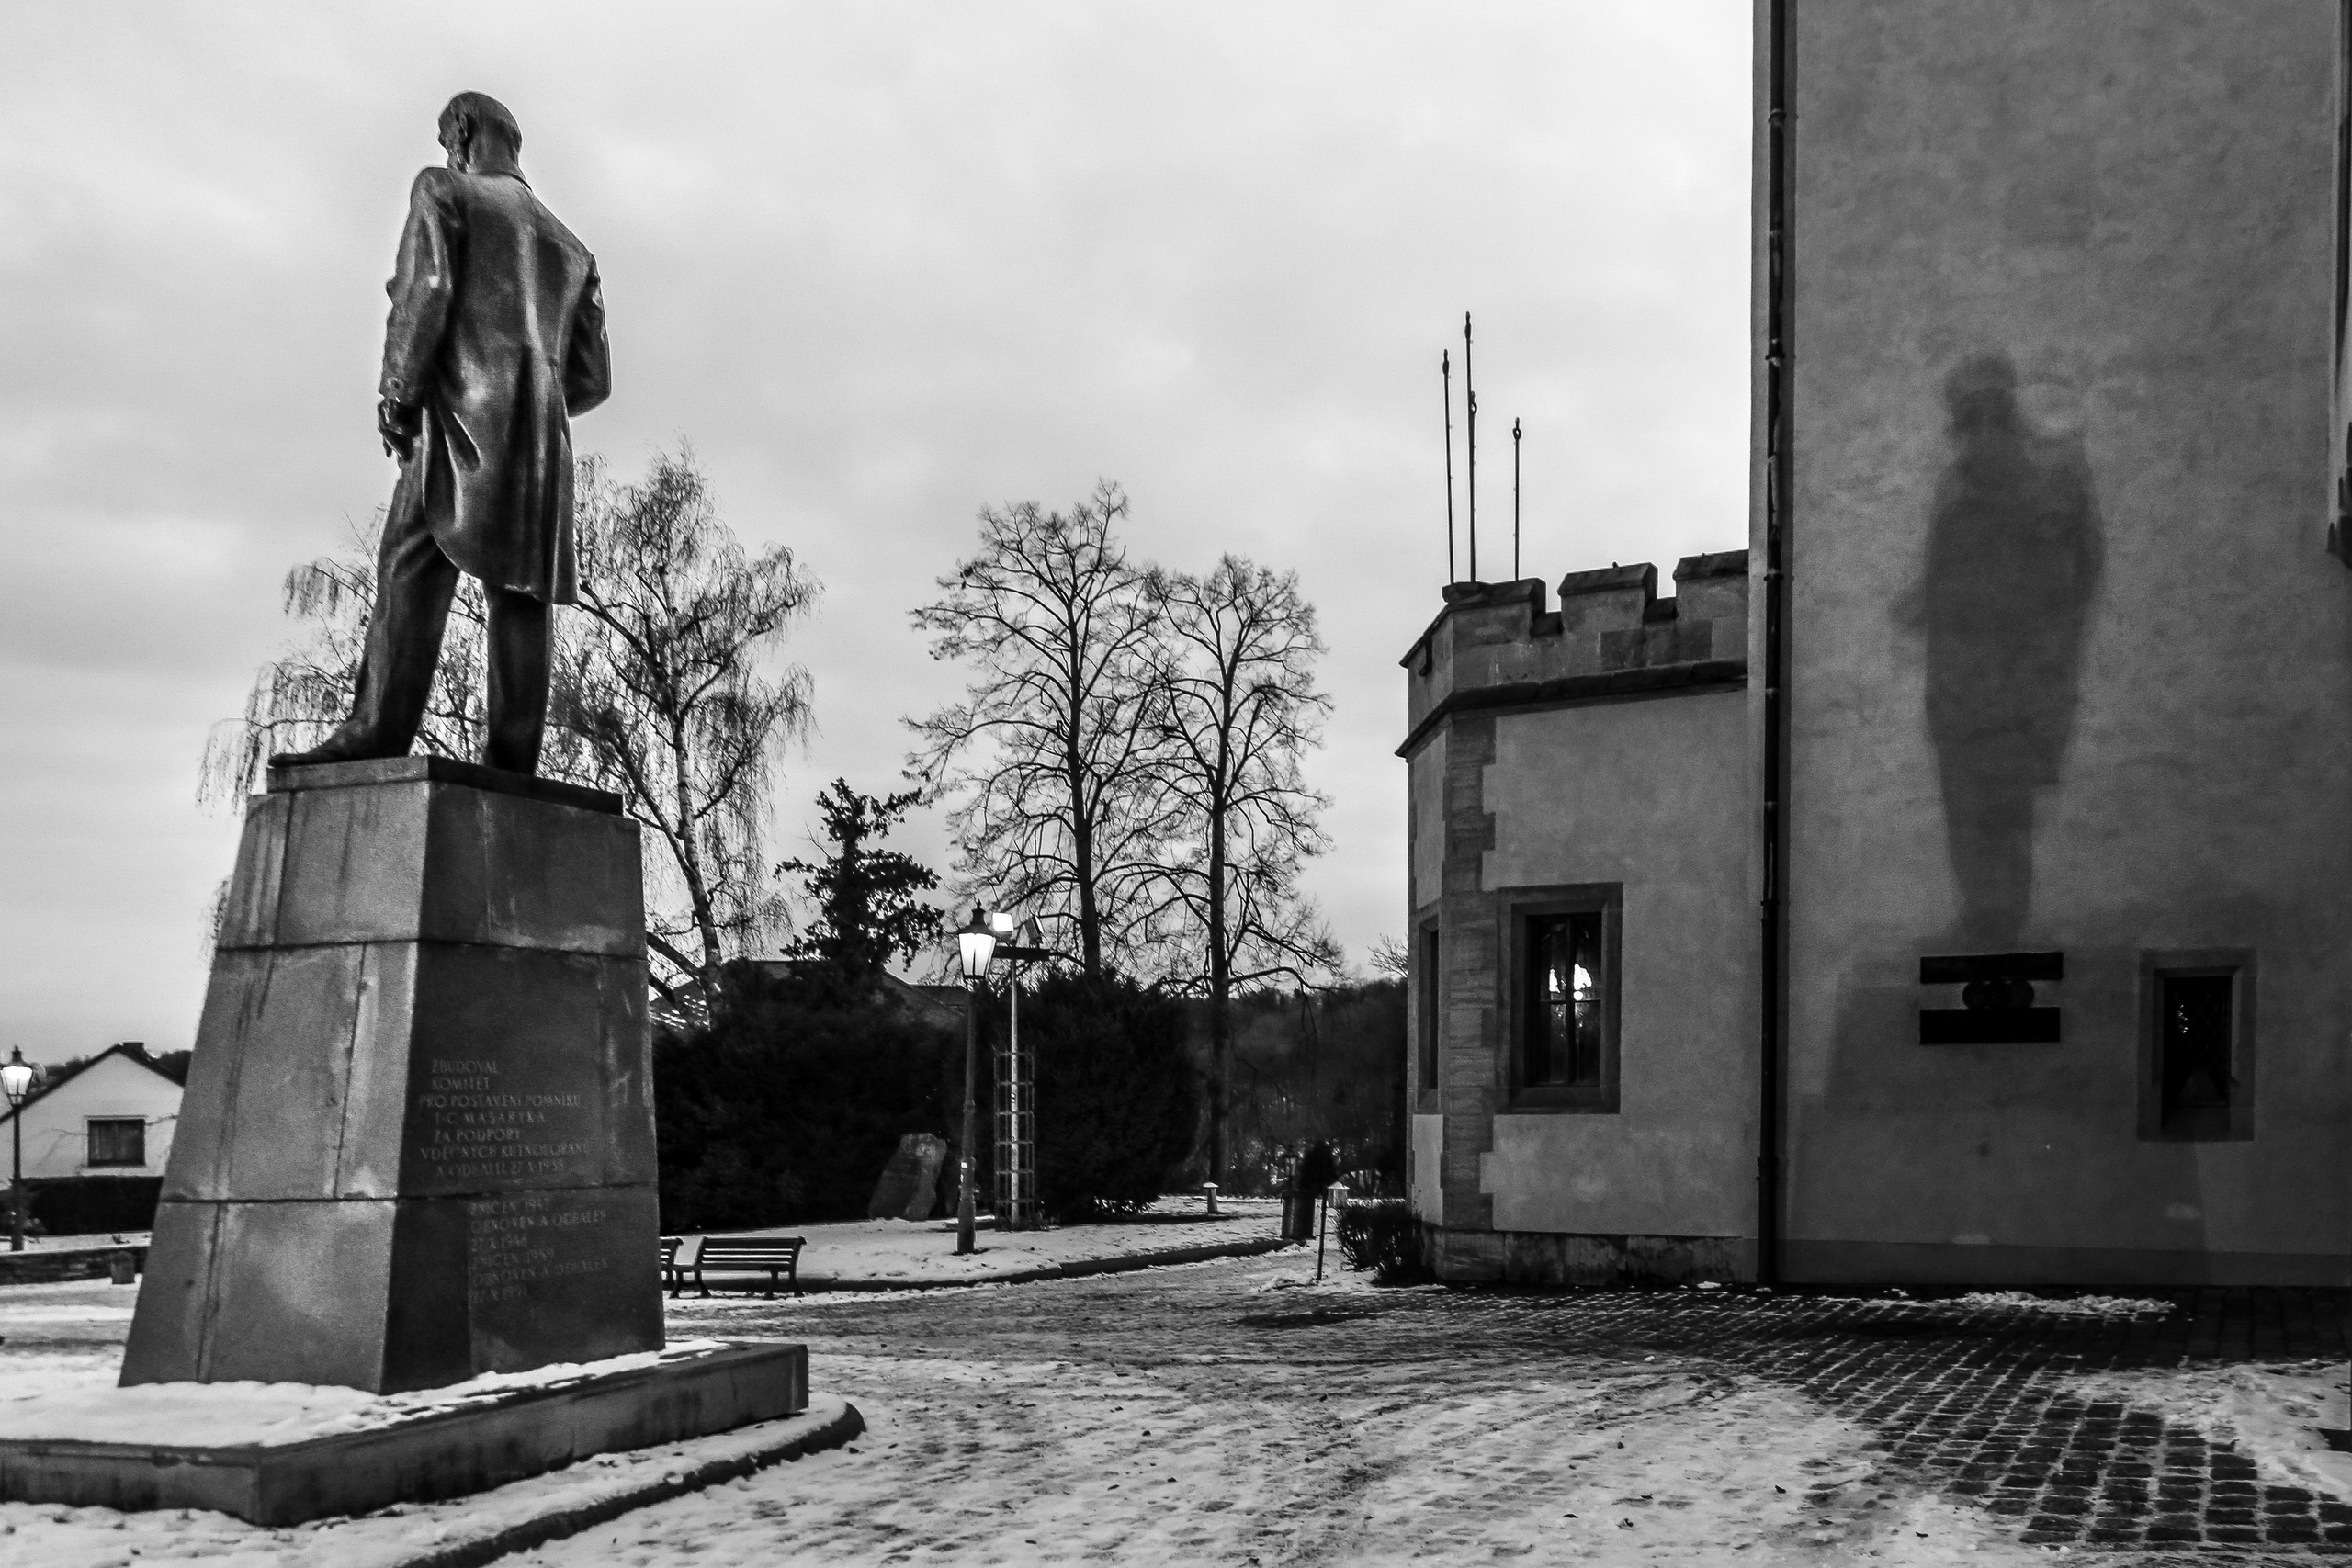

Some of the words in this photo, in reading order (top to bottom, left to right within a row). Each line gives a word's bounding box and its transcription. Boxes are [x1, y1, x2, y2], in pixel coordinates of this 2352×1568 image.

[432, 1077, 489, 1090] KOMITET
[419, 1094, 447, 1108] PRO
[457, 1128, 520, 1142] PODPORY
